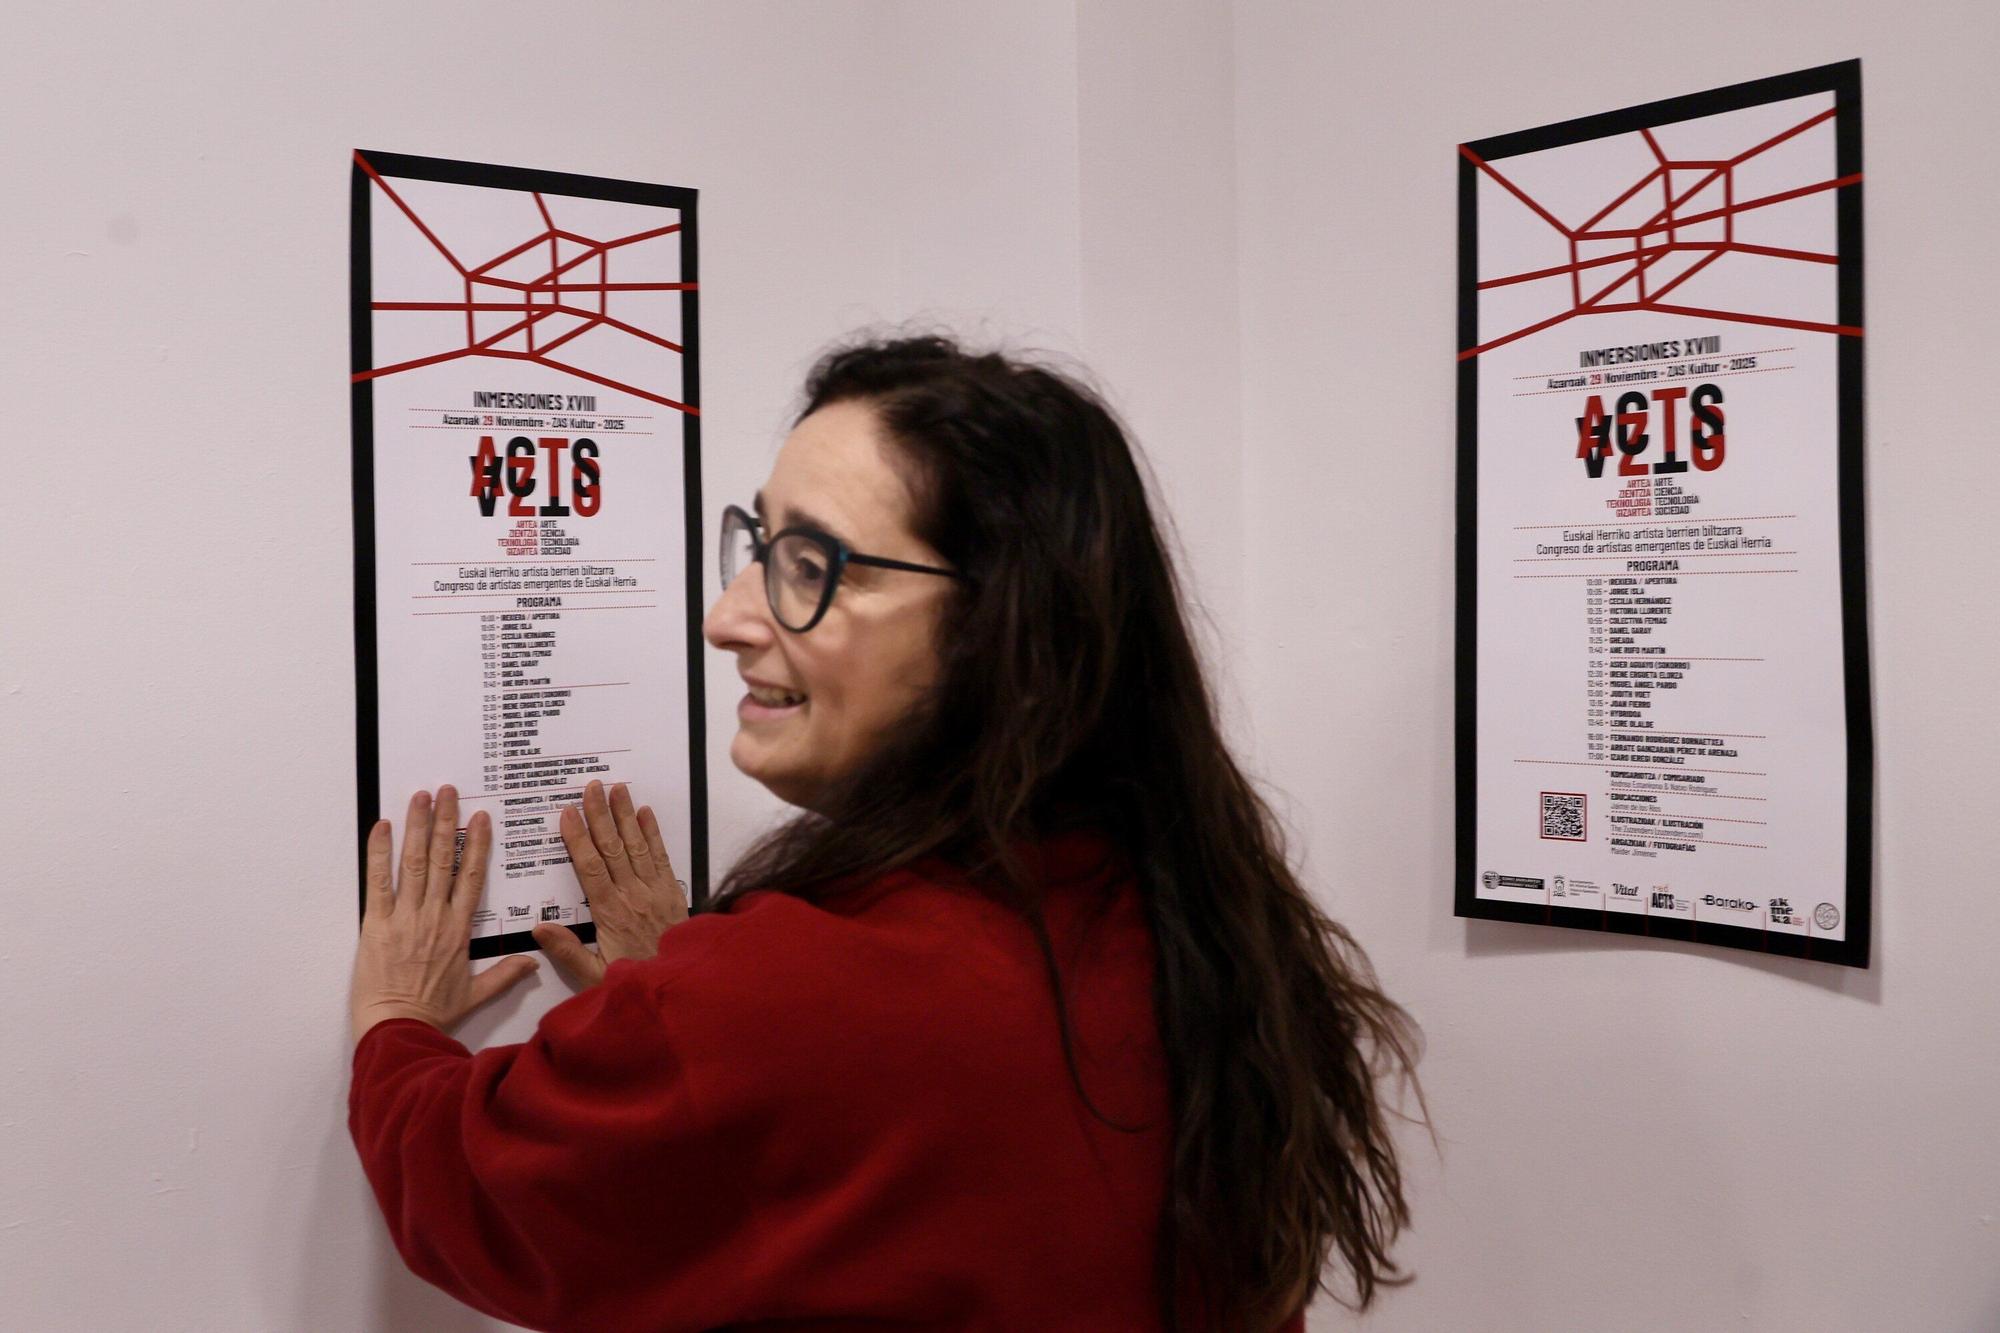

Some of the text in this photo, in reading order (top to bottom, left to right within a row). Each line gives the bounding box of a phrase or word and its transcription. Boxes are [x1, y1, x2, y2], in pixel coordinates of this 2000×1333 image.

[1580, 335, 1720, 368] INMERSIONES XVIII
[1547, 356, 1757, 390] Azaroak 29 Noviembre ZAS Kultur 2025
[474, 391, 596, 412] INMERSIONES XVIII
[443, 414, 624, 430] Azaroak 29 Noviembre ZAS Kultur 2025
[1627, 477, 1673, 488] ARTEA ARTE
[1618, 487, 1682, 498] ZIENTZIA CIENCIA
[1606, 498, 1651, 508] TEKNOLOGIA
[1616, 506, 1689, 518] GIZARTEA SOCIEDAD
[516, 520, 557, 528] ARTEA ARTE
[509, 529, 565, 537] ZIENTZIA CIENCIA
[1563, 525, 1742, 542] Euskal Herriko artista berrien biltzarra
[506, 547, 571, 556] GIZARTEA SOCIEDAD
[1536, 536, 1772, 558] Congreso de artistas emergentes de Euskal Herria
[459, 566, 614, 578] Euskal Herriko artista berrien biltzarra
[1627, 560, 1679, 572] PROGRAMA
[434, 577, 636, 593] Congreso de artistas emergentes de Euskal Herria
[516, 597, 561, 608] PROGRAMA
[1609, 607, 1638, 615] VICTORIA
[1631, 627, 1652, 635] GARAY
[1610, 671, 1628, 679] IRENE
[1610, 700, 1627, 708] JOAN
[1610, 734, 1644, 743] FERNANDO
[1612, 882, 1640, 897] Vital
[1652, 893, 1674, 910] ACTS
[1705, 894, 1754, 911] Barako
[508, 905, 531, 917] Vital
[542, 905, 560, 921] ACTS
